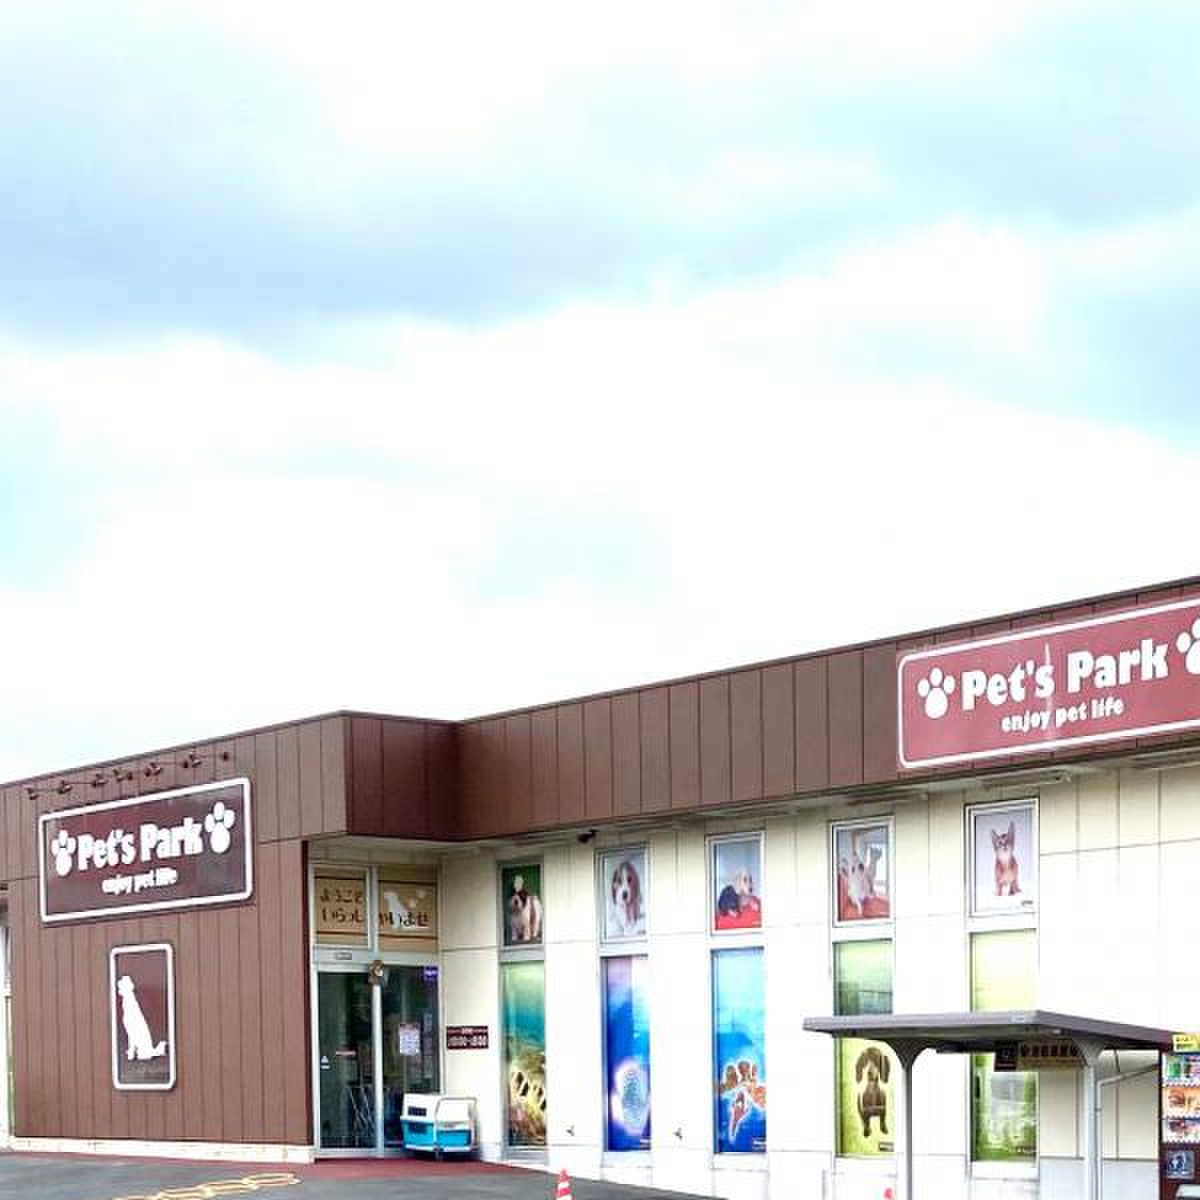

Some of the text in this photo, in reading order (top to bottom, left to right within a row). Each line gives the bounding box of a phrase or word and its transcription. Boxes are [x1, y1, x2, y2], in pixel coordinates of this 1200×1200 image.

[960, 638, 1169, 711] Pet's Park
[1001, 697, 1125, 733] enjoy pet life
[77, 817, 204, 871] Pet's Park
[134, 869, 155, 893] pet
